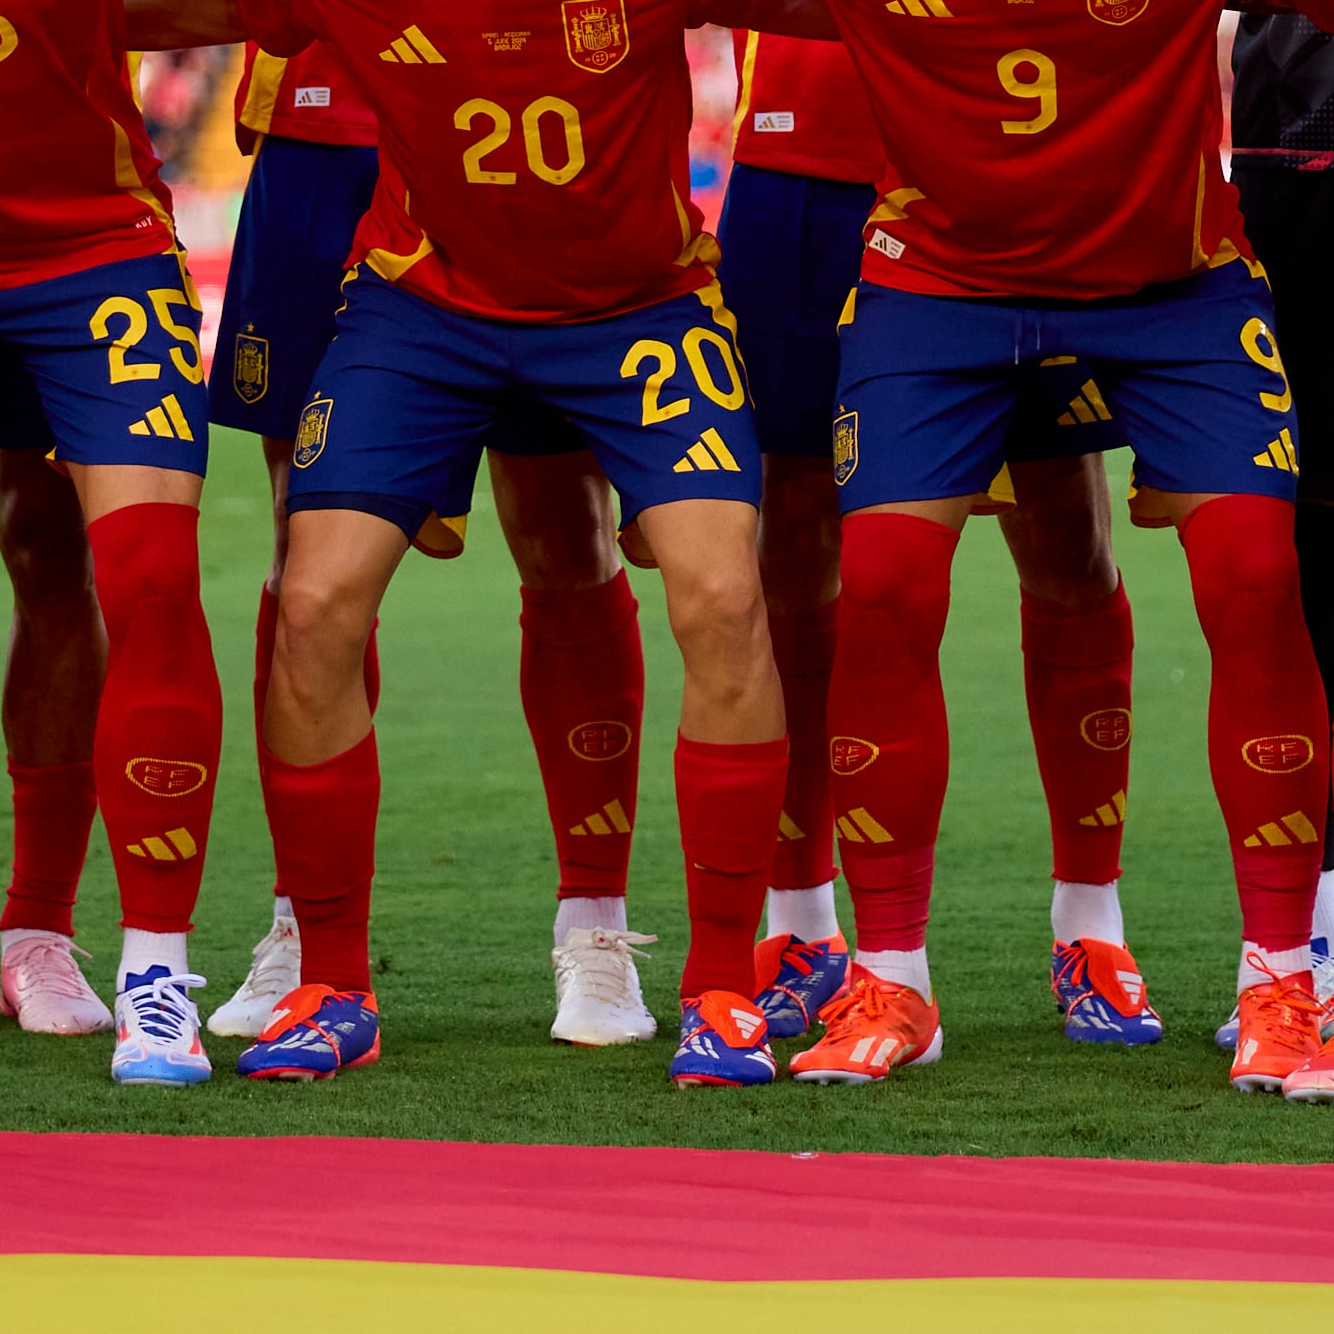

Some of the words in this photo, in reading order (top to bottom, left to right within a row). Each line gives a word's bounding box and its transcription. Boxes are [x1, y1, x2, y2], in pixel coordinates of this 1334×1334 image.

[997, 49, 1057, 134] 9
[454, 96, 585, 185] 20
[90, 289, 204, 384] 25
[621, 327, 744, 426] 20
[1240, 317, 1292, 412] 9
[1096, 716, 1124, 727] RF
[1097, 729, 1124, 741] EF
